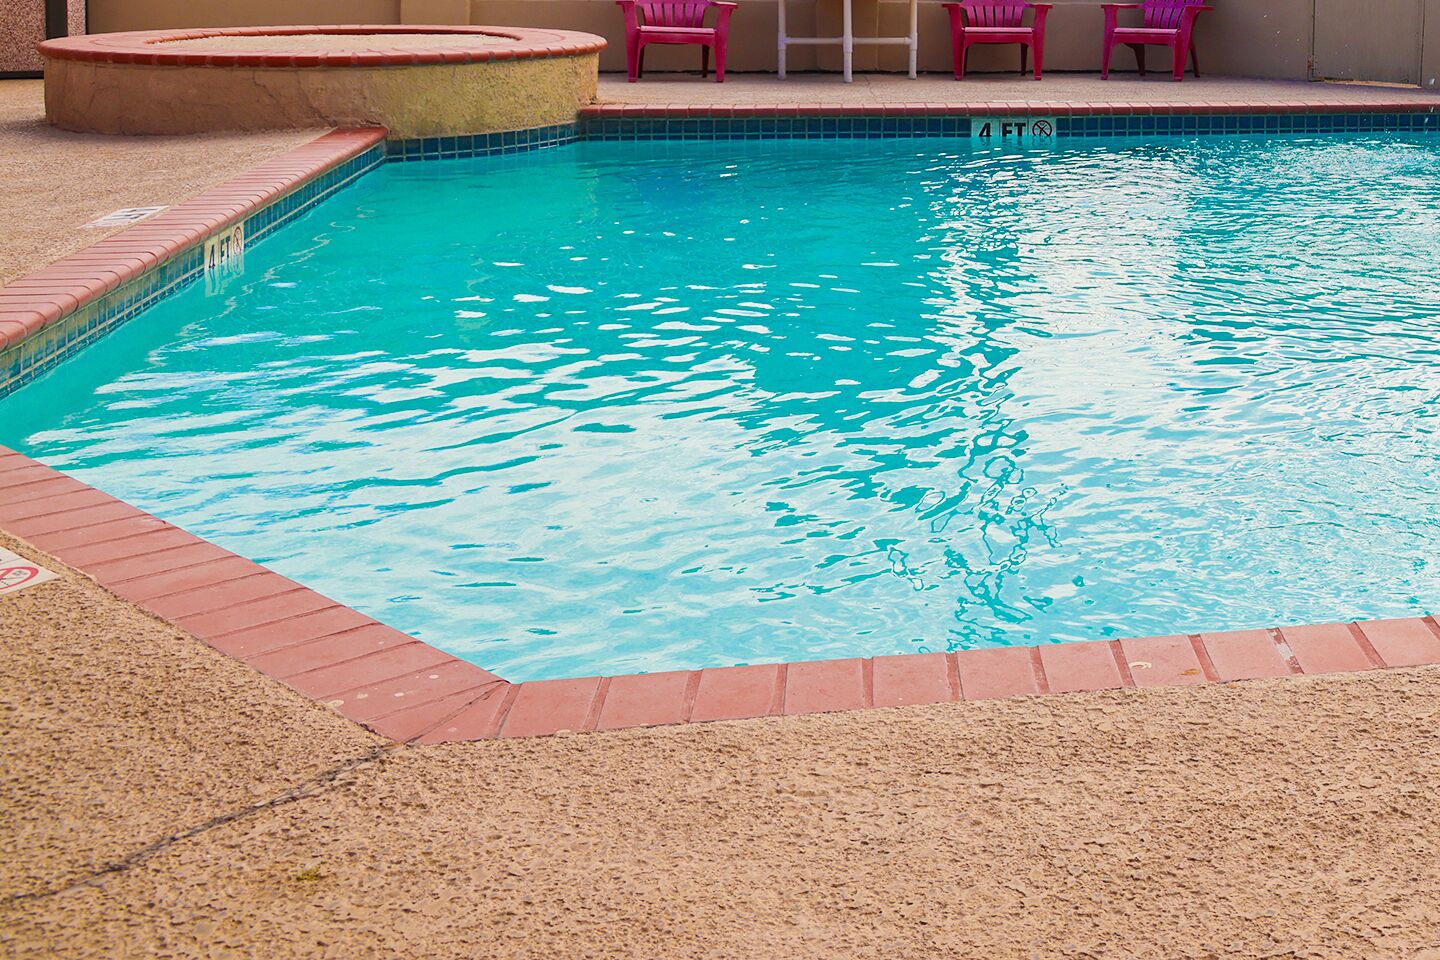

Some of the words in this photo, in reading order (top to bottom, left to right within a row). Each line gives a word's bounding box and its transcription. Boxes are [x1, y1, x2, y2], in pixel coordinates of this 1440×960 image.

[979, 123, 992, 137] 4
[1002, 123, 1026, 137] FT
[209, 244, 215, 268] 4
[220, 236, 230, 264] FT
